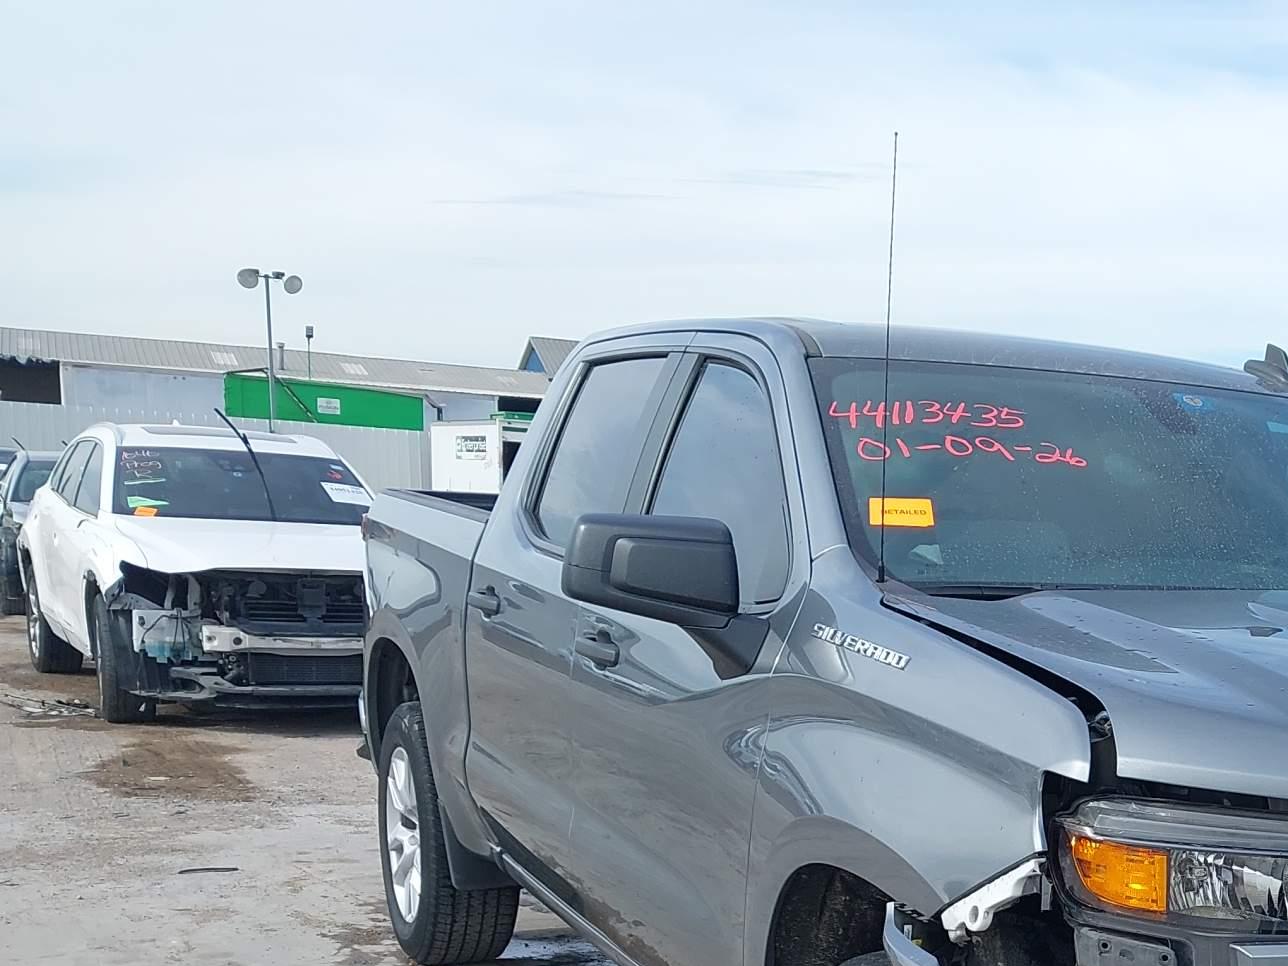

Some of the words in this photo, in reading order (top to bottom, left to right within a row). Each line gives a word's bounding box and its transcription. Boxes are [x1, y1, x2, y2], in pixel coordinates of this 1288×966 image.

[829, 401, 1025, 428] 44113435
[857, 435, 1088, 467] 01-09-26
[811, 622, 912, 671] SILVERADO
